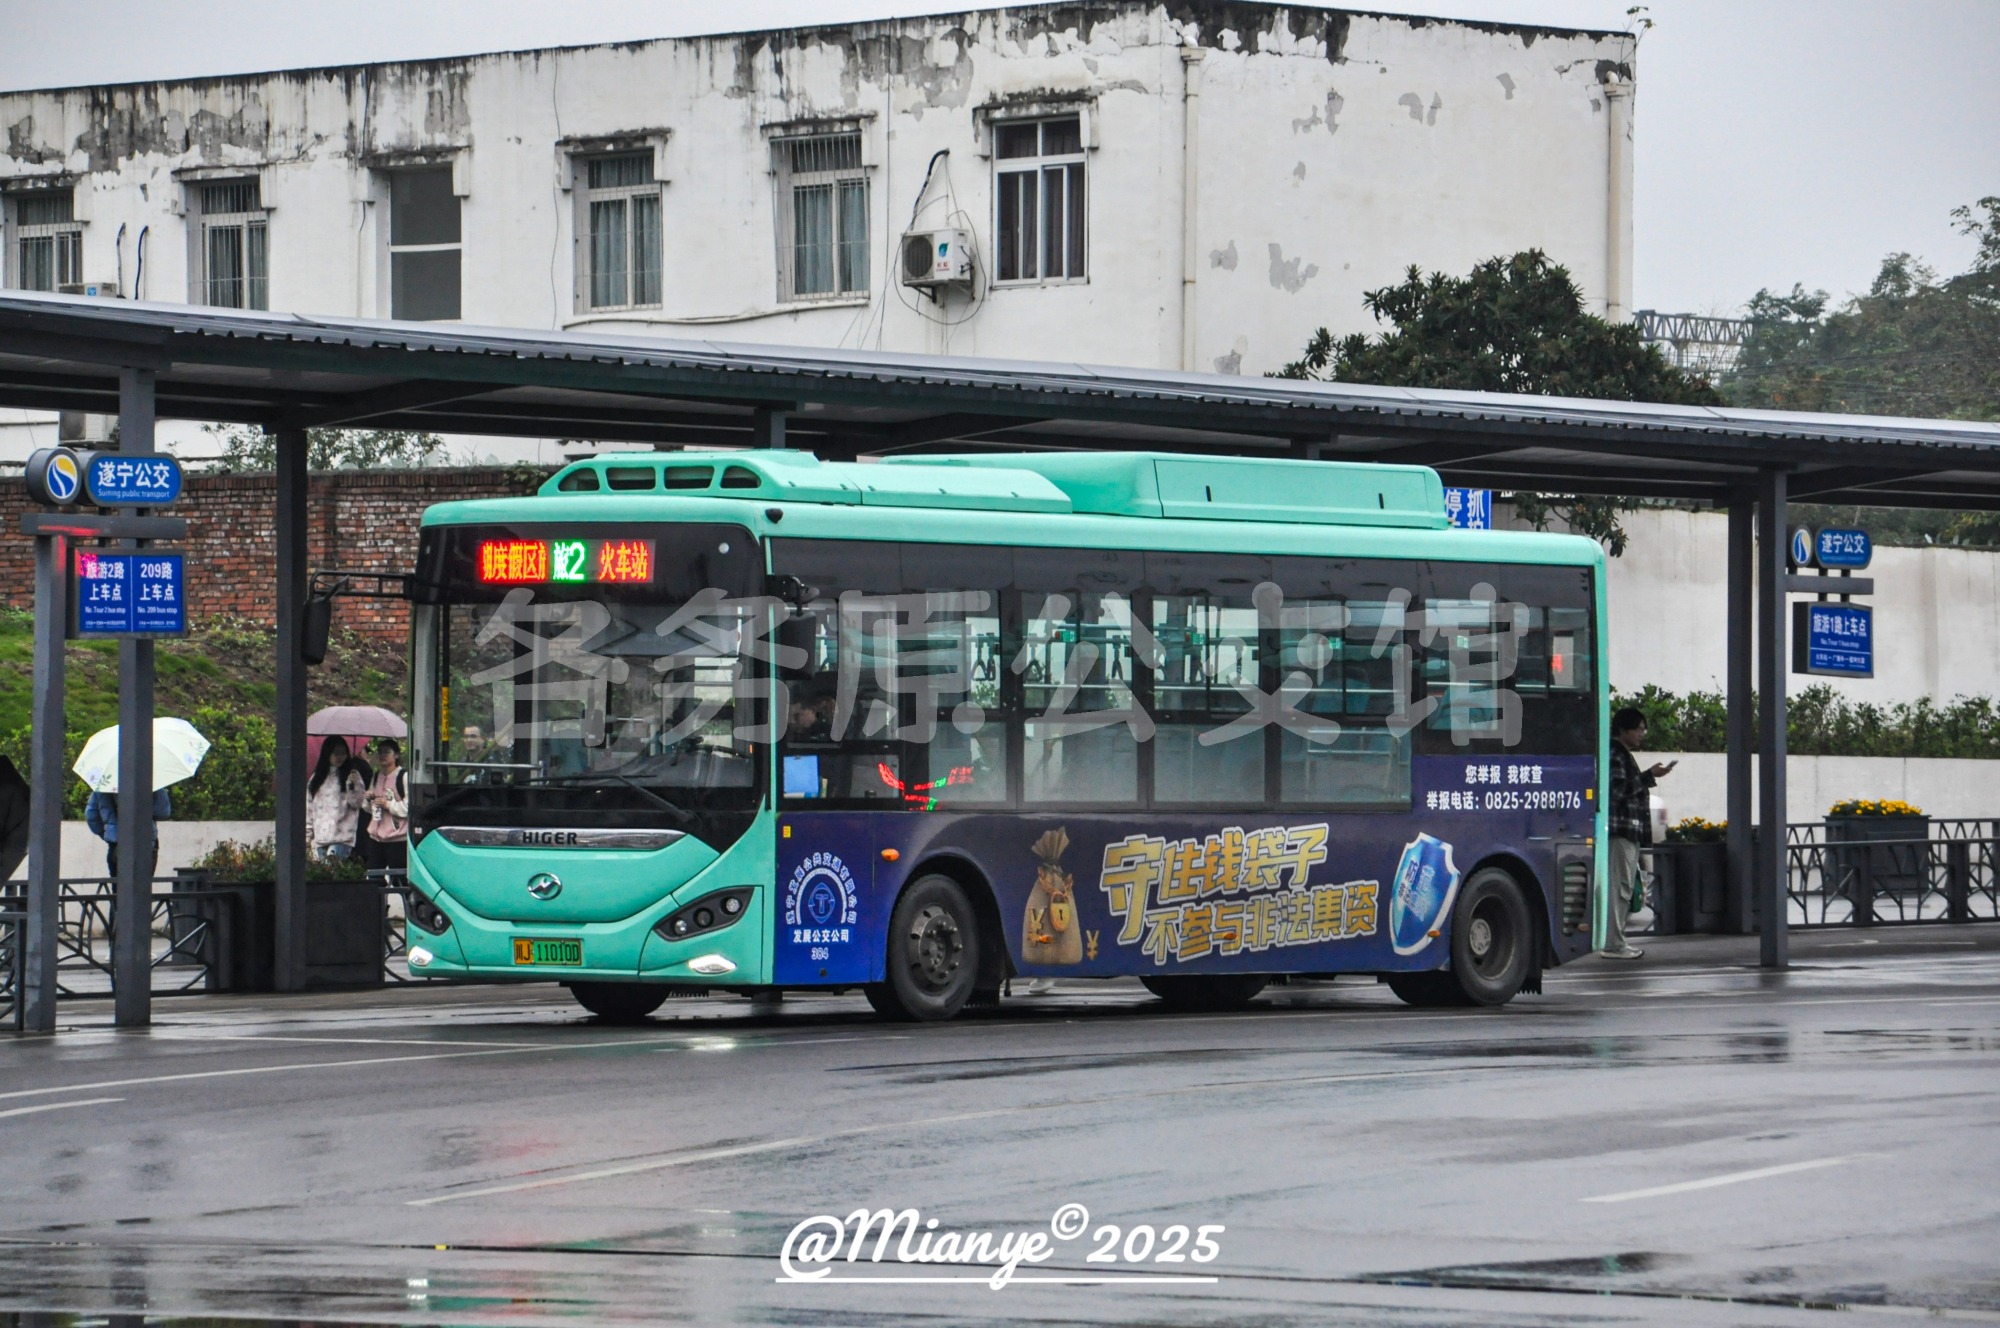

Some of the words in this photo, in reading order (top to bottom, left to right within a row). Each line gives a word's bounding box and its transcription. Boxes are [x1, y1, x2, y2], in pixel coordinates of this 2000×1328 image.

[98, 461, 169, 488] 遂宁公交
[98, 489, 121, 499] Suining
[122, 490, 141, 498] public
[1822, 533, 1864, 553] 遂宁公交
[86, 561, 125, 580] 旅游2路
[140, 561, 173, 580] 209路
[599, 542, 648, 580] 火车站
[89, 583, 122, 601] 上车点
[140, 583, 175, 601] 上车点
[166, 607, 178, 615] stop
[1813, 613, 1867, 637] 旅游1路上车点
[1465, 765, 1501, 784] 您举报
[1507, 765, 1543, 784] 我核查
[522, 831, 578, 844] HIGER
[1100, 823, 1329, 944] 守住钱袋子
[1142, 880, 1379, 965] 不参与非法集资
[793, 929, 849, 943] 发展公交公司
[811, 947, 829, 960] 384
